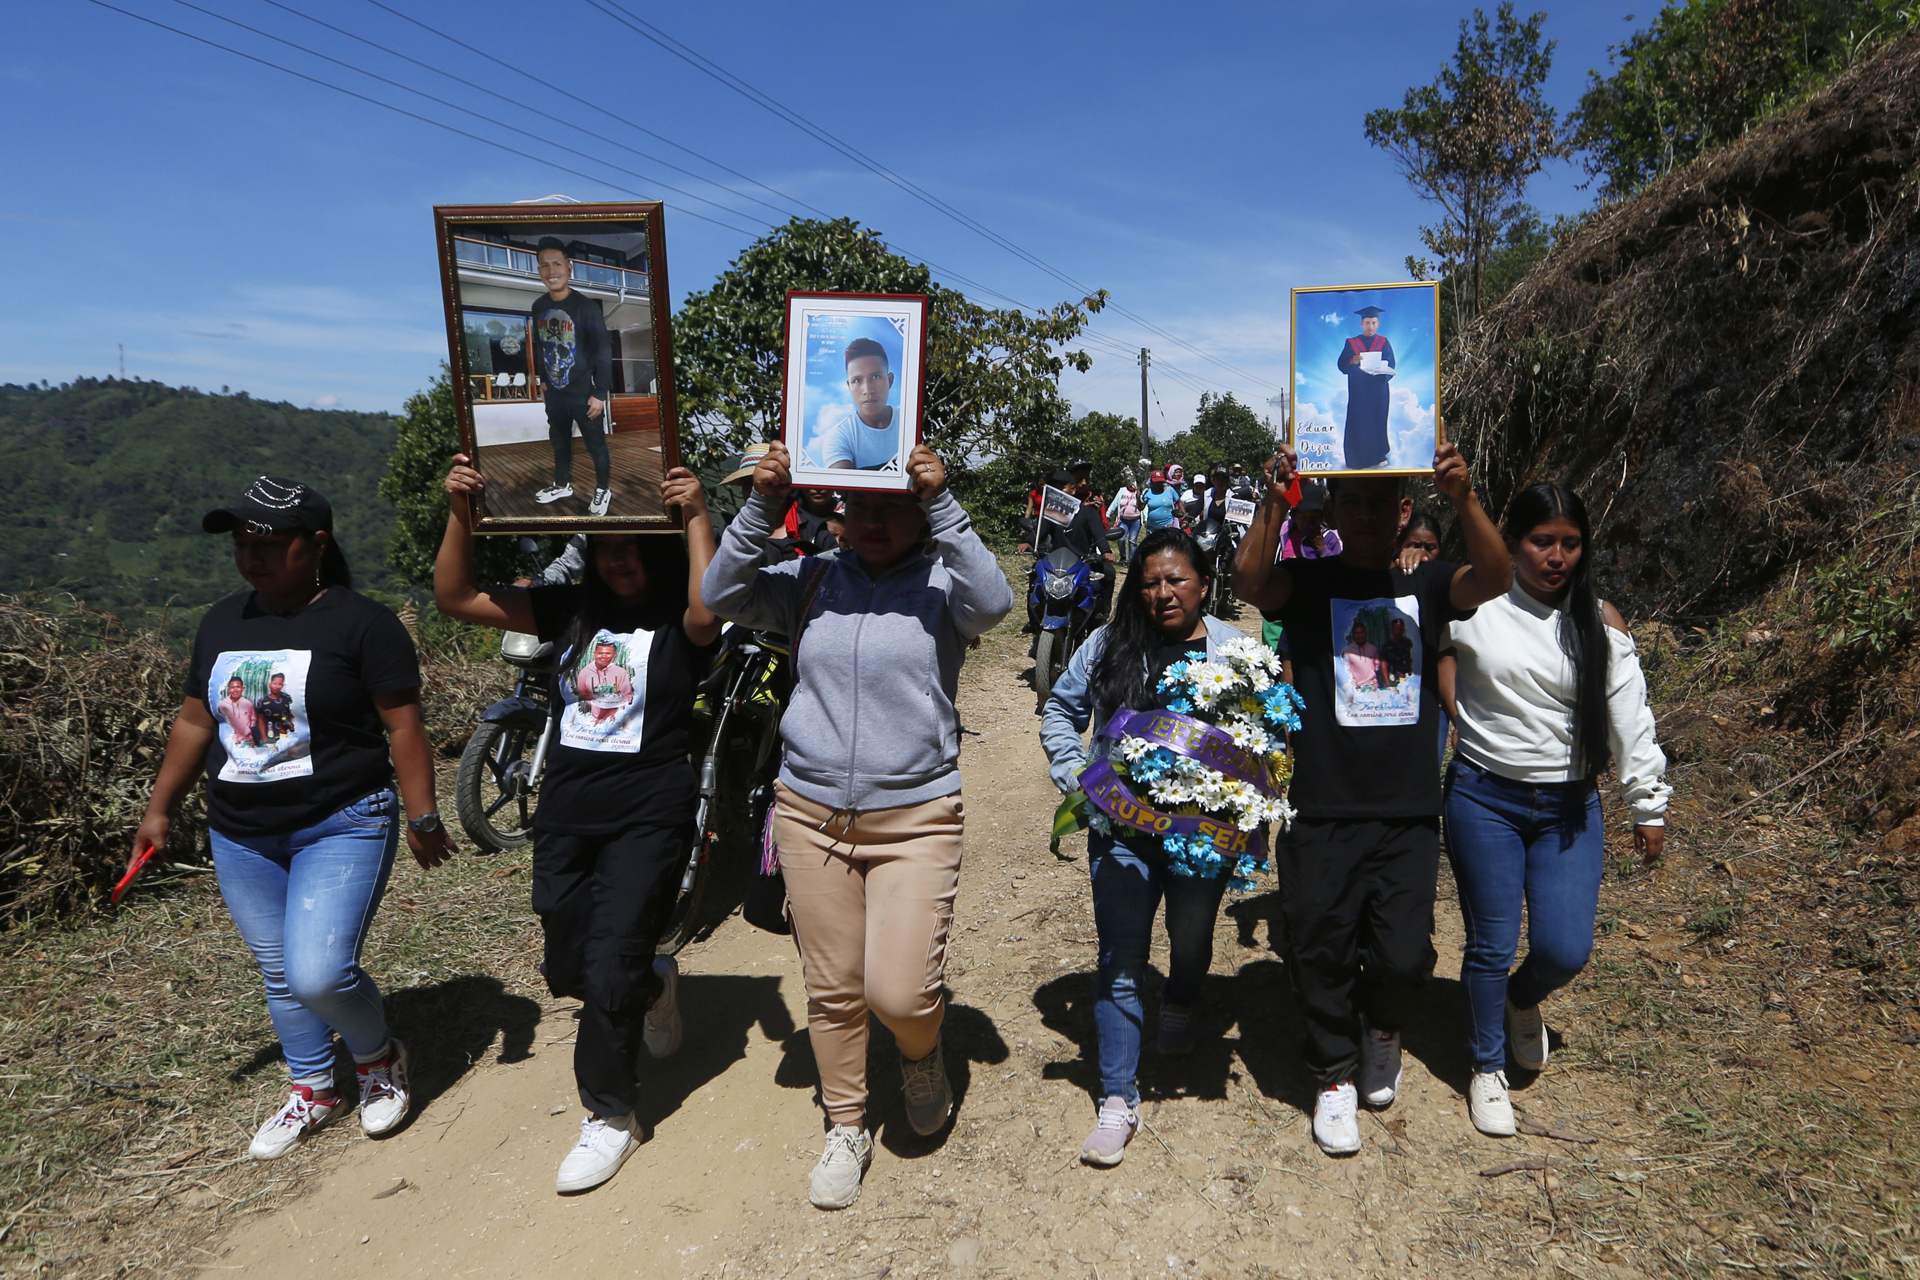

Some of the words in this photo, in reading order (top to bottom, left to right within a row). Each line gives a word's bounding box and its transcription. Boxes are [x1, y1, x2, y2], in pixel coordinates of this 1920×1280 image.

[1297, 421, 1335, 436] Eduar
[1300, 440, 1332, 455] Dizu
[1299, 458, 1332, 471] Nene
[1141, 715, 1262, 779] JEFERSON
[1094, 775, 1172, 832] GRUPO
[1197, 821, 1251, 853] SEK
